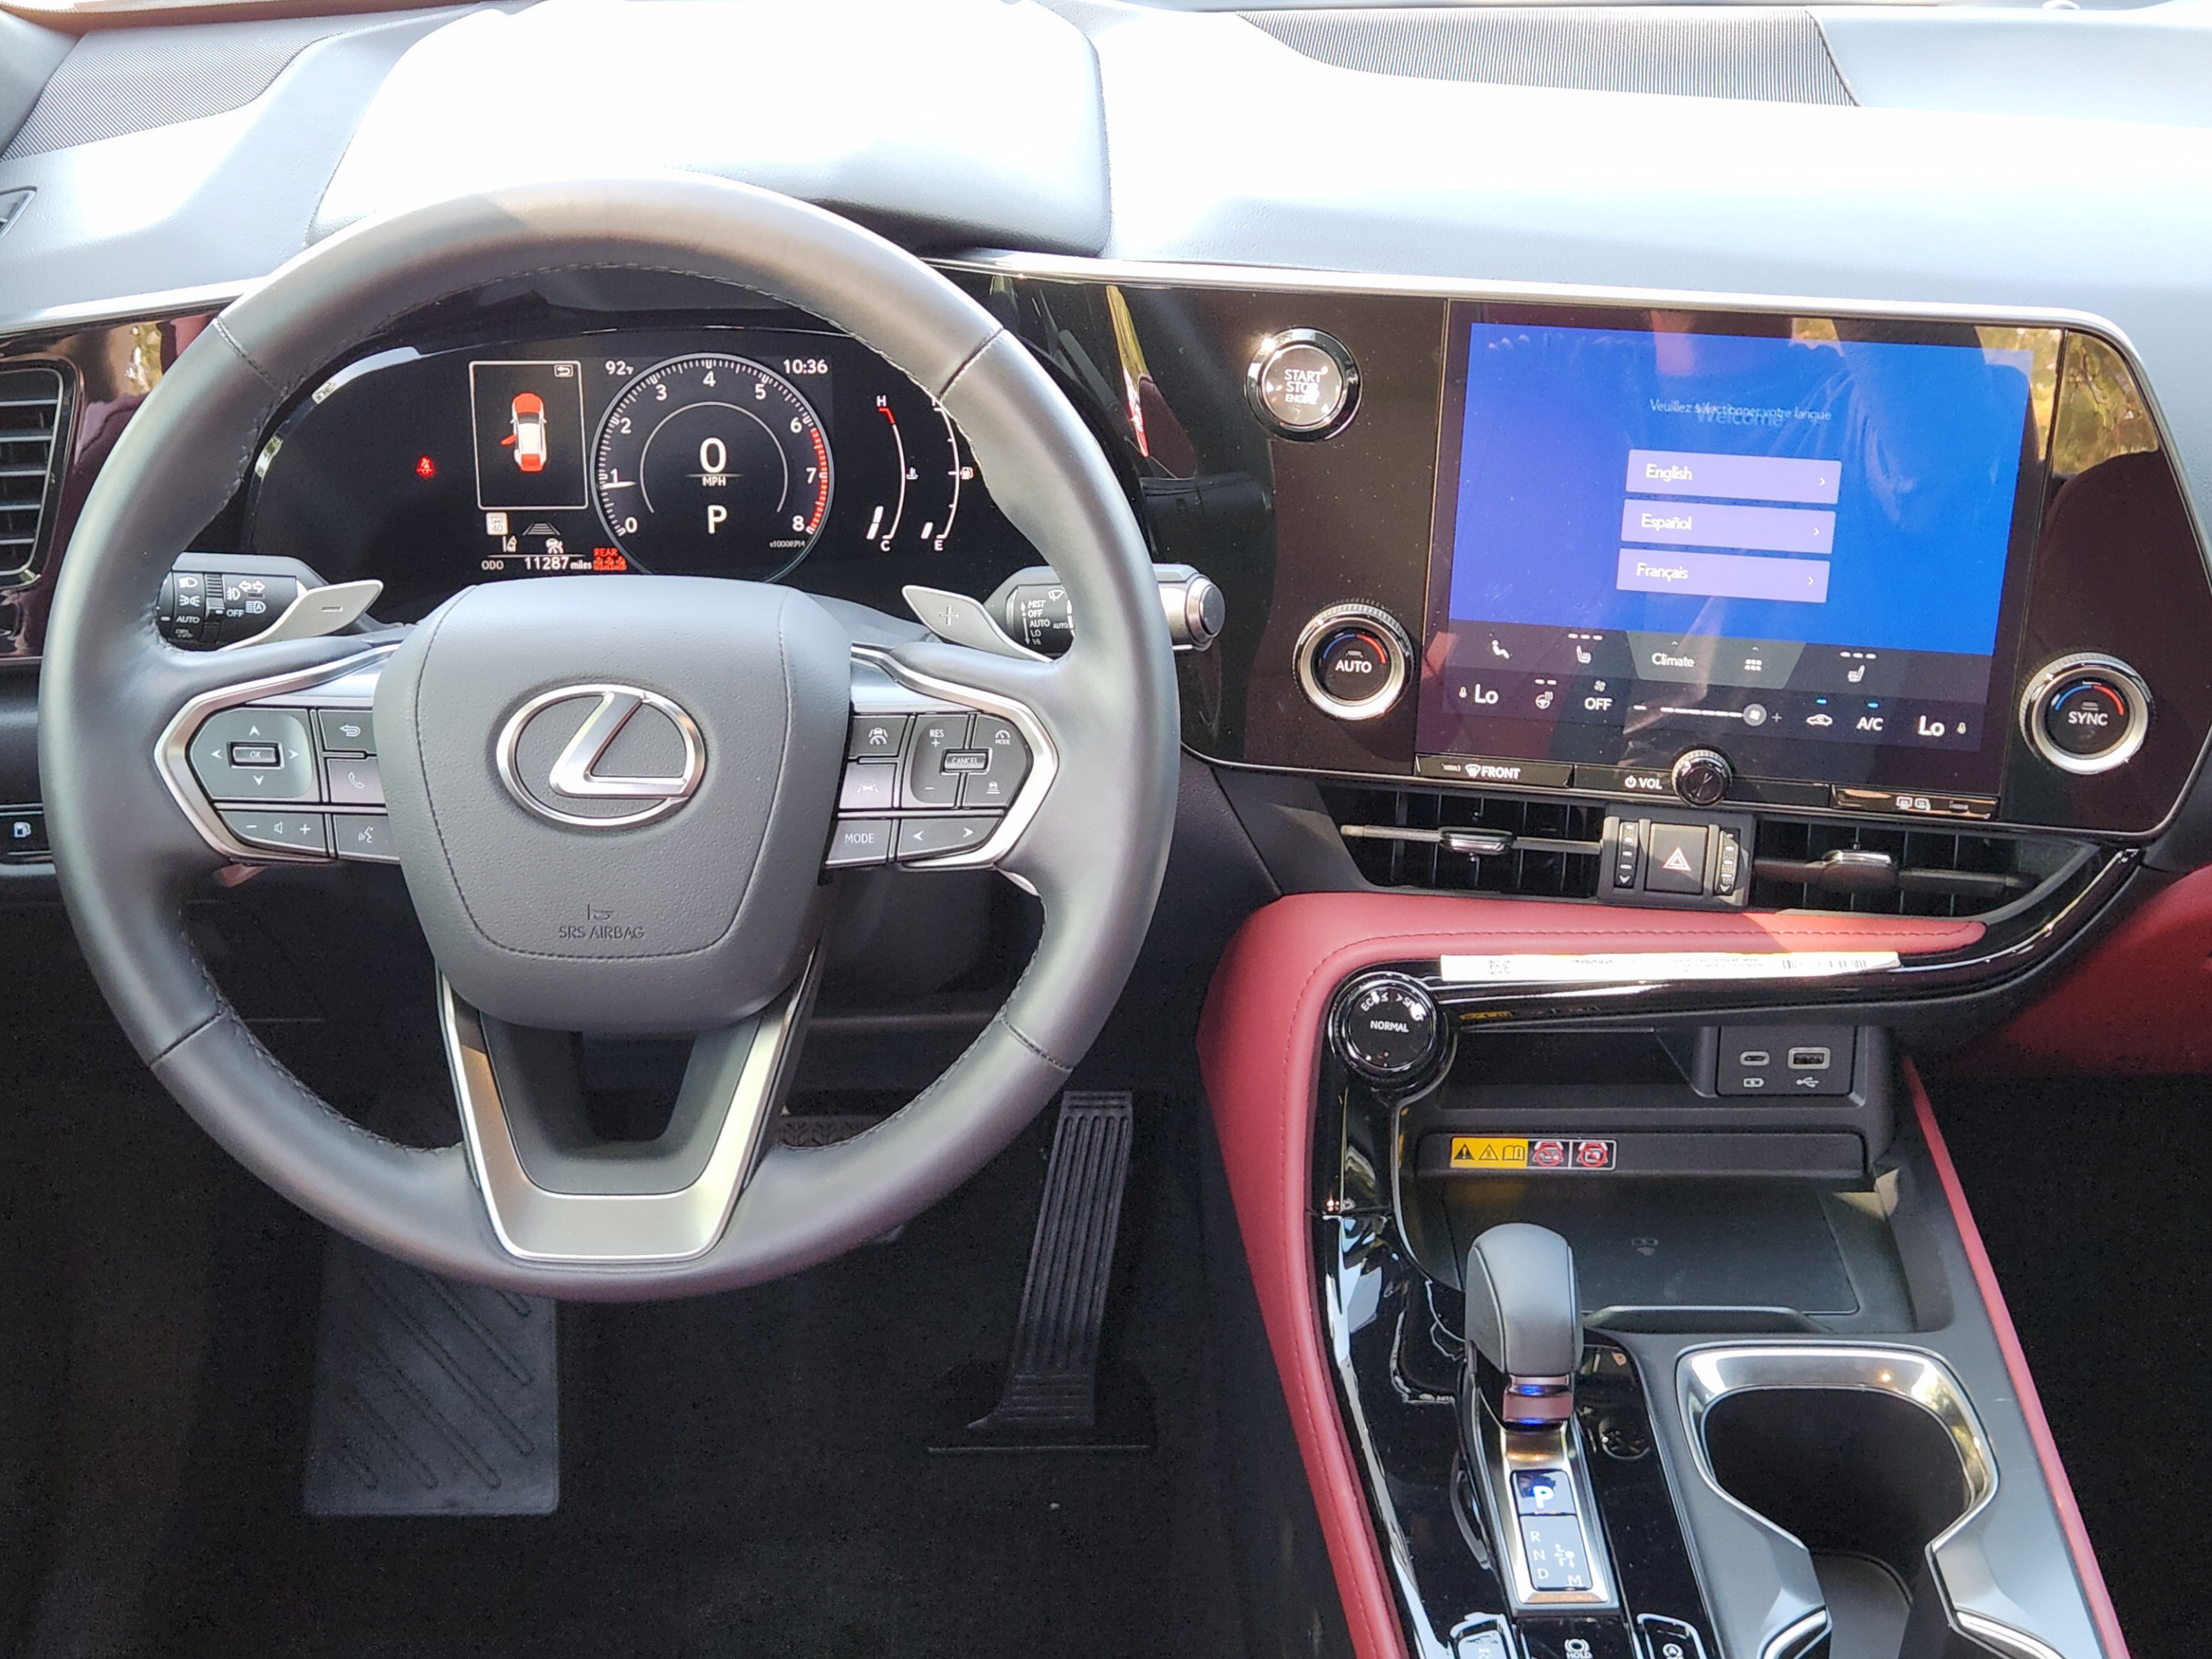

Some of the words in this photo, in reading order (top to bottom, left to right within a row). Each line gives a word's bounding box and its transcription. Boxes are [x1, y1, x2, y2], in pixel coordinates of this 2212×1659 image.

[783, 359, 828, 374] 10:36
[703, 371, 716, 387] 4
[1284, 369, 1320, 382] START
[656, 384, 667, 401] 3
[755, 384, 767, 399] 5
[876, 396, 887, 407] H
[1651, 399, 1691, 413] Veuillez
[1794, 406, 1832, 422] langue
[621, 418, 632, 434] 2
[790, 417, 803, 433] 6
[700, 438, 727, 473] 0
[611, 469, 618, 484] 1
[806, 468, 816, 484] 7
[1646, 463, 1693, 482] English
[703, 477, 726, 487] MPH
[625, 517, 638, 533] 0
[707, 505, 727, 534] P
[793, 515, 805, 532] 8
[1641, 513, 1692, 531] Español
[594, 548, 618, 557] REAR
[881, 541, 890, 551] C
[935, 541, 944, 551] E
[482, 561, 504, 571] ODO
[525, 557, 569, 571] 11287
[570, 559, 592, 570] miles
[1636, 562, 1689, 581] Français
[1028, 600, 1046, 608] MIST
[177, 615, 200, 624] AUTO
[227, 609, 244, 618] OFF
[1028, 609, 1044, 618] OFF
[1030, 619, 1051, 628] AUTO
[1031, 629, 1041, 637] LO
[1652, 653, 1694, 667] Climate
[1335, 660, 1373, 674] AUTO
[1475, 684, 1498, 704] Lo
[1584, 697, 1613, 710] OFF
[1856, 717, 1883, 730] A/C
[2068, 711, 2108, 726] SYNC
[1919, 716, 1945, 737] Lo
[930, 730, 945, 738] RES
[1482, 767, 1521, 780] FRONT
[1639, 777, 1663, 790] VOL
[845, 833, 875, 844] MODE
[559, 926, 586, 939] SRS
[589, 926, 645, 939] AIRBAG
[1370, 1020, 1409, 1033] NORMAL
[1533, 1485, 1554, 1508] P
[1531, 1532, 1541, 1542] R
[1533, 1550, 1546, 1561] N
[1538, 1568, 1549, 1579] D
[1568, 1575, 1584, 1586] M
